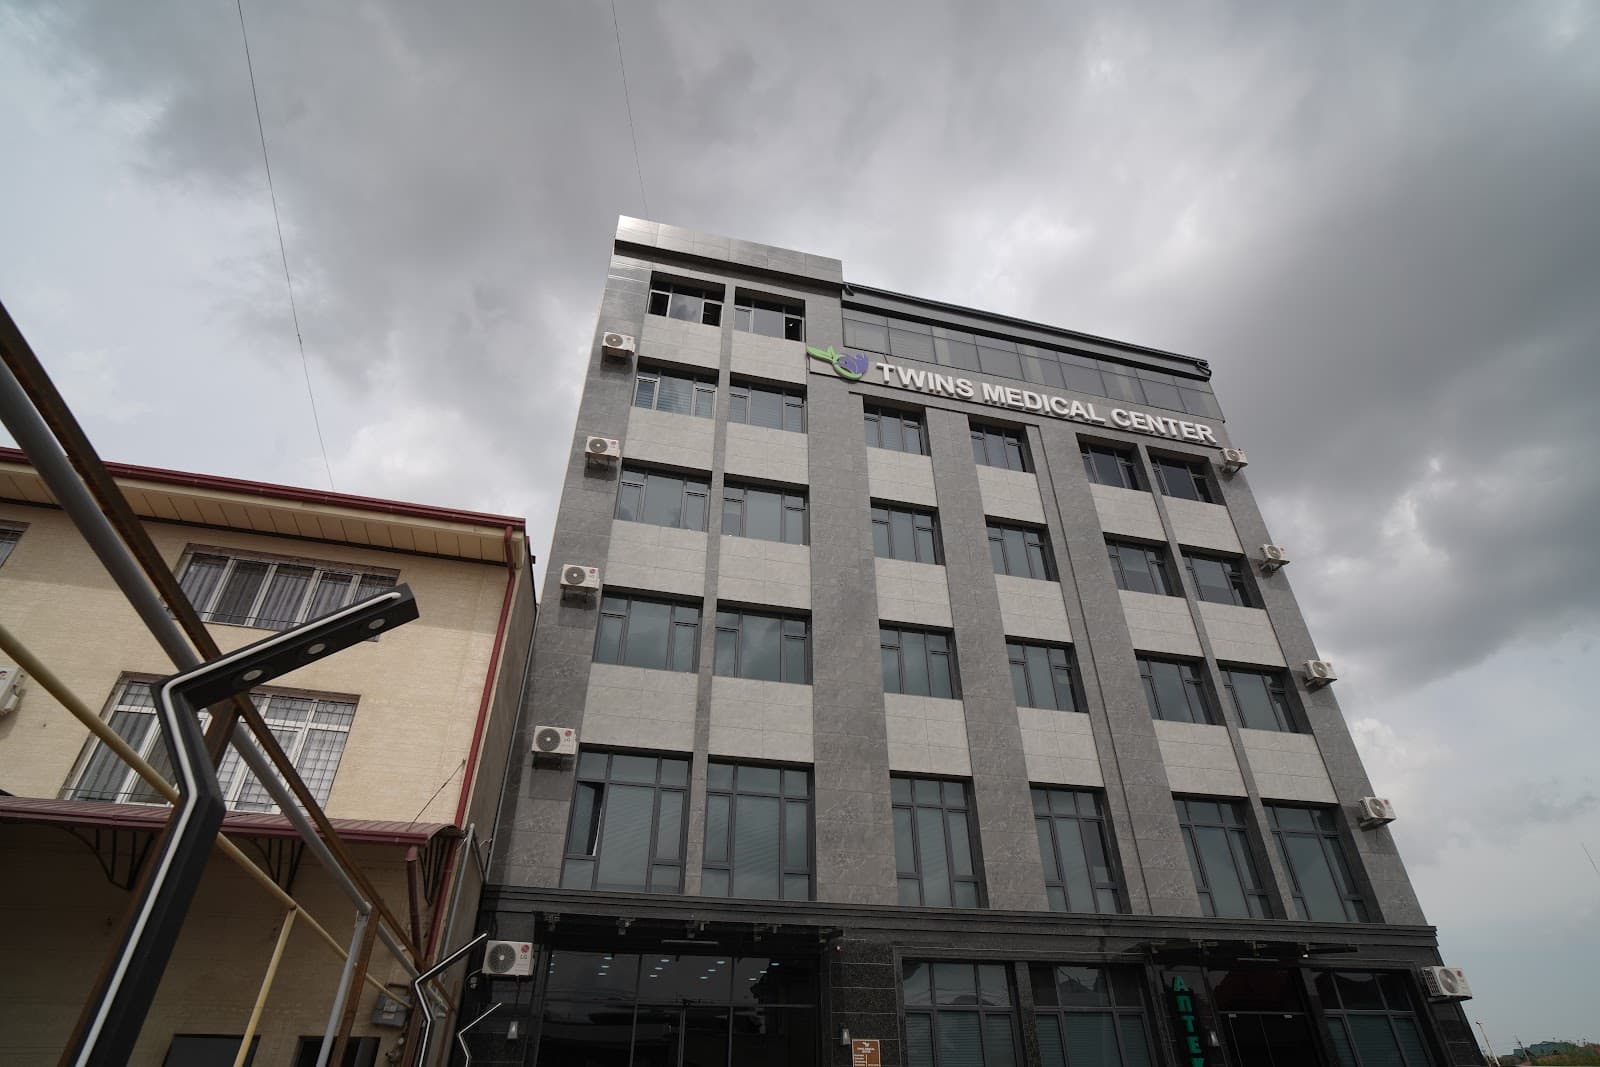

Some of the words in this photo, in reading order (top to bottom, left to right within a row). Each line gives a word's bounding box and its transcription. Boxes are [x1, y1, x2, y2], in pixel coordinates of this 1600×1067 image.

[876, 362, 974, 399] TWINS
[981, 382, 1106, 423] MEDICAL
[1110, 407, 1217, 444] CENTER
